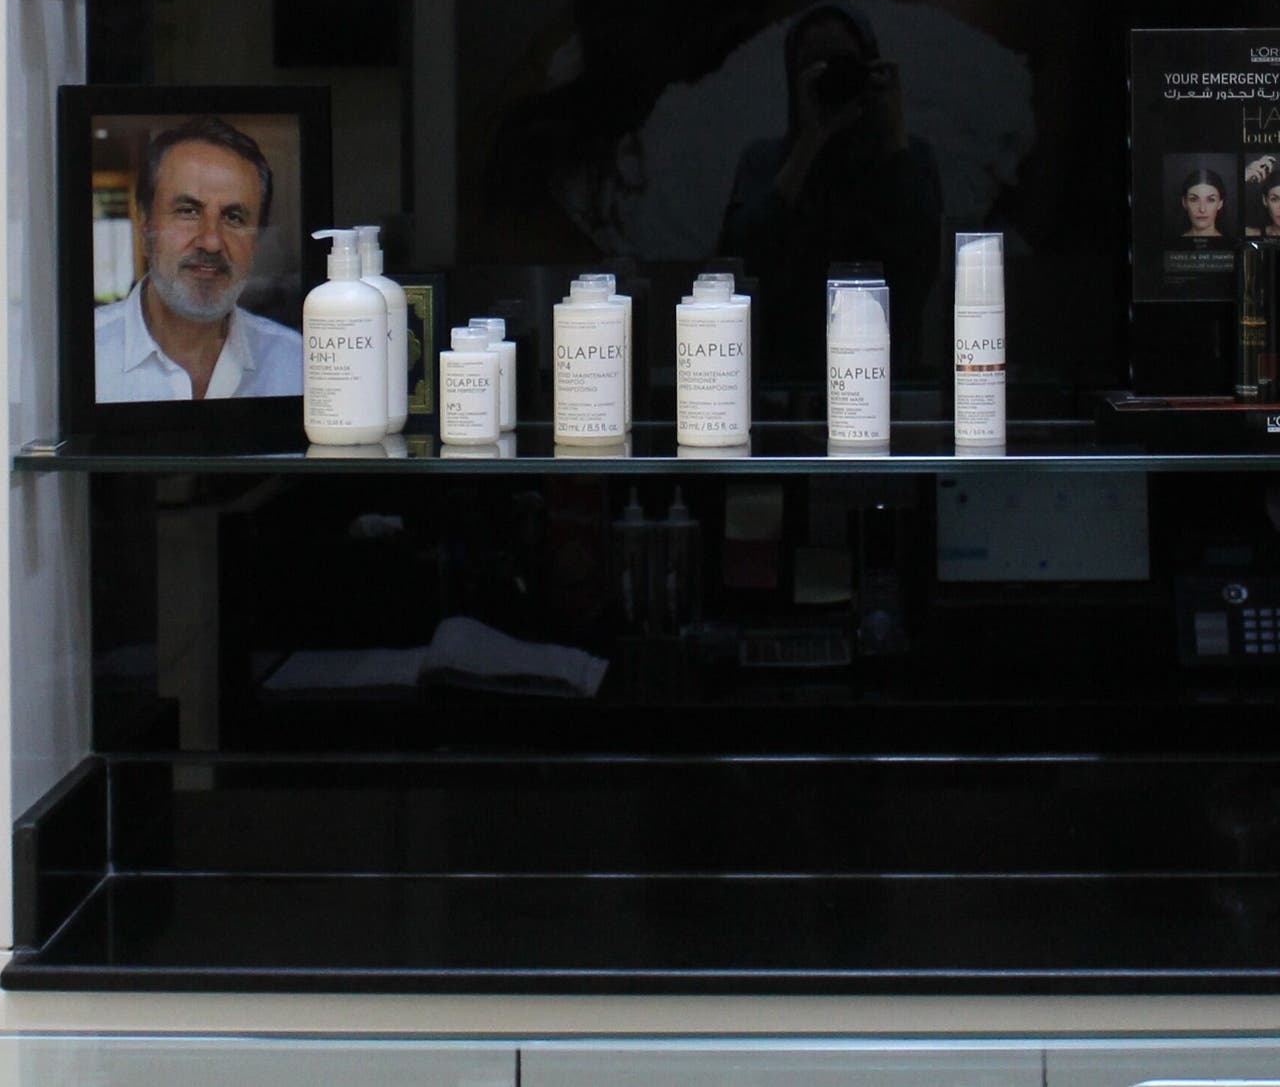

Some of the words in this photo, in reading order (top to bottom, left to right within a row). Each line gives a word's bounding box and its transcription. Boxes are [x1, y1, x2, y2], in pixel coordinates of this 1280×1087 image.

[1164, 72, 1199, 84] YOUR
[1201, 72, 1279, 84] EMERGENCY
[308, 335, 373, 350] OLAPLEX
[956, 338, 1006, 350] OLAPLE
[557, 345, 623, 360] OLAPLEX
[678, 342, 744, 358] OLAPLEX
[830, 366, 886, 380] OLAPLEX
[446, 377, 490, 387] OLAPLEX
[587, 423, 600, 432] 8.5
[706, 422, 720, 431] 8.5
